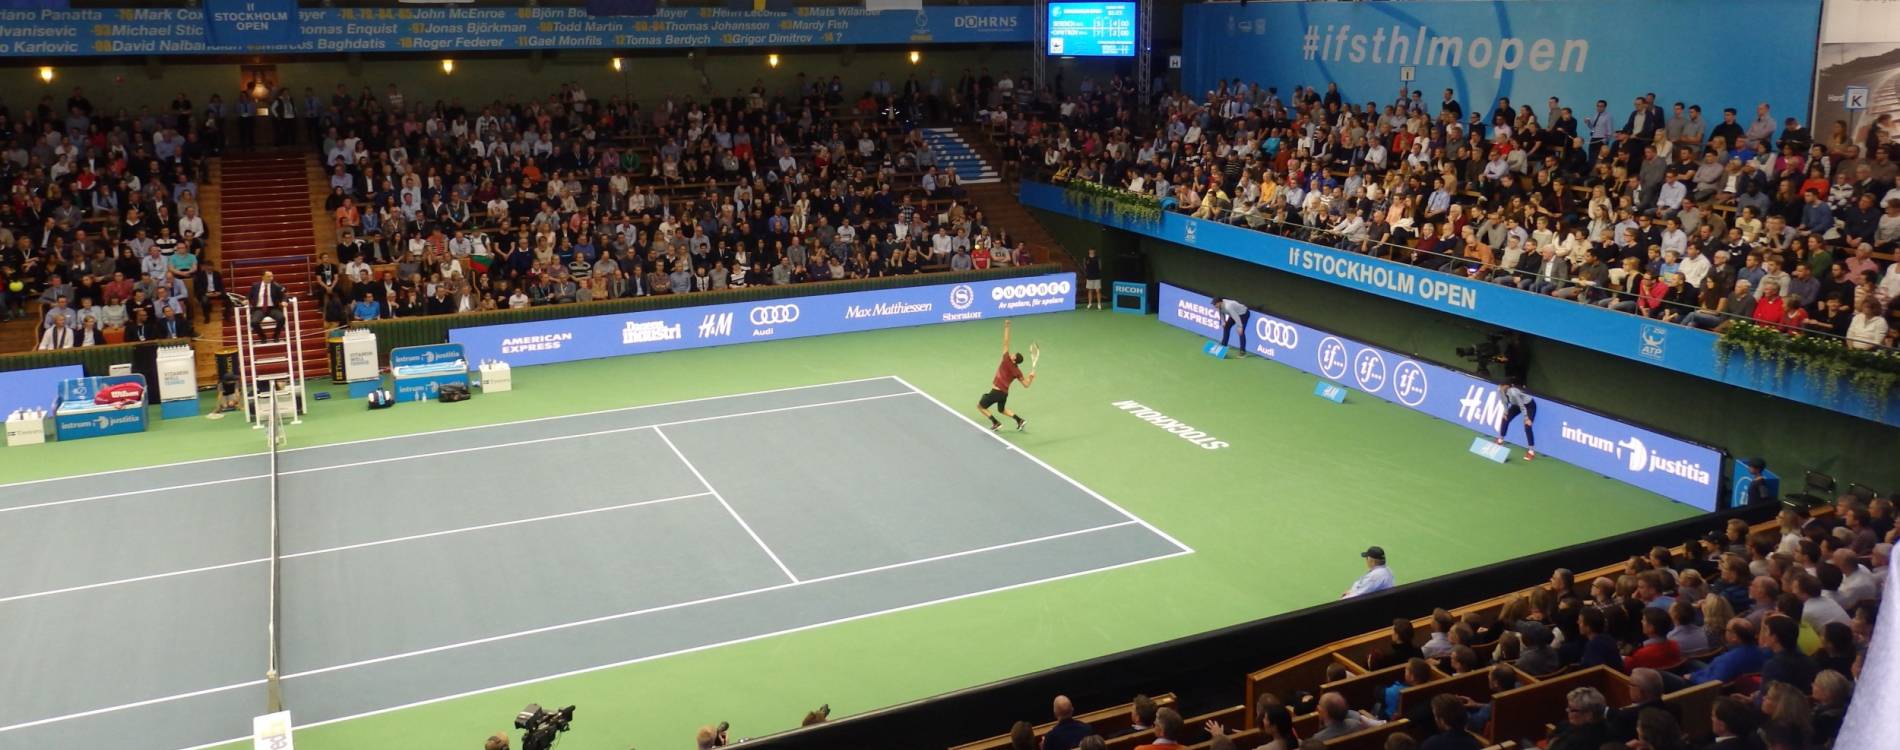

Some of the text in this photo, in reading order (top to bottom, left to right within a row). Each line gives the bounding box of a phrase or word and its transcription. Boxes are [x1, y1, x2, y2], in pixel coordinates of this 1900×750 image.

[42, 8, 102, 21] Panatta
[134, 8, 173, 20] Mark
[215, 12, 288, 22] STOCKHOLM
[413, 7, 444, 20] John
[448, 8, 506, 19] McEnroe
[531, 7, 564, 20] Björn
[236, 22, 269, 32] OPEN
[424, 23, 463, 33] Jonas
[466, 21, 526, 35] Björkman
[552, 21, 581, 32] Todd
[585, 22, 623, 33] Martin
[664, 20, 710, 31] Thomas
[711, 20, 770, 31] Johansson
[828, 19, 849, 30] Fish
[954, 15, 1017, 30] DOHRNS
[112, 24, 171, 36] Michael
[346, 24, 397, 37] Enquist
[317, 38, 386, 51] Baghdatis
[413, 37, 451, 50] Roger
[455, 36, 504, 48] Federer
[528, 35, 556, 46] Gael
[559, 34, 602, 46] Monfils
[625, 35, 662, 45] Tomas
[665, 33, 711, 47] Berdych
[732, 33, 766, 46] Grigor
[768, 32, 813, 44] Dimitrov
[14, 41, 79, 53] Karlovic
[112, 40, 154, 52] David
[1302, 24, 1589, 80] #ifsthlmopen
[1851, 95, 1864, 107] K
[1301, 249, 1415, 294] STOCKHOLM
[1418, 278, 1477, 309] OPEN
[1115, 286, 1143, 294] RICOH
[845, 301, 933, 320] Max Matthiessen
[698, 312, 734, 338] H&M
[752, 327, 774, 337] Audi
[502, 332, 573, 347] AMERICAN
[502, 342, 561, 355] EXPRESS
[1257, 343, 1275, 357] Audi
[61, 415, 140, 431] intrum justitia
[1111, 399, 1230, 450] STOCKHOLM
[1561, 421, 1710, 486] intrum justitia
